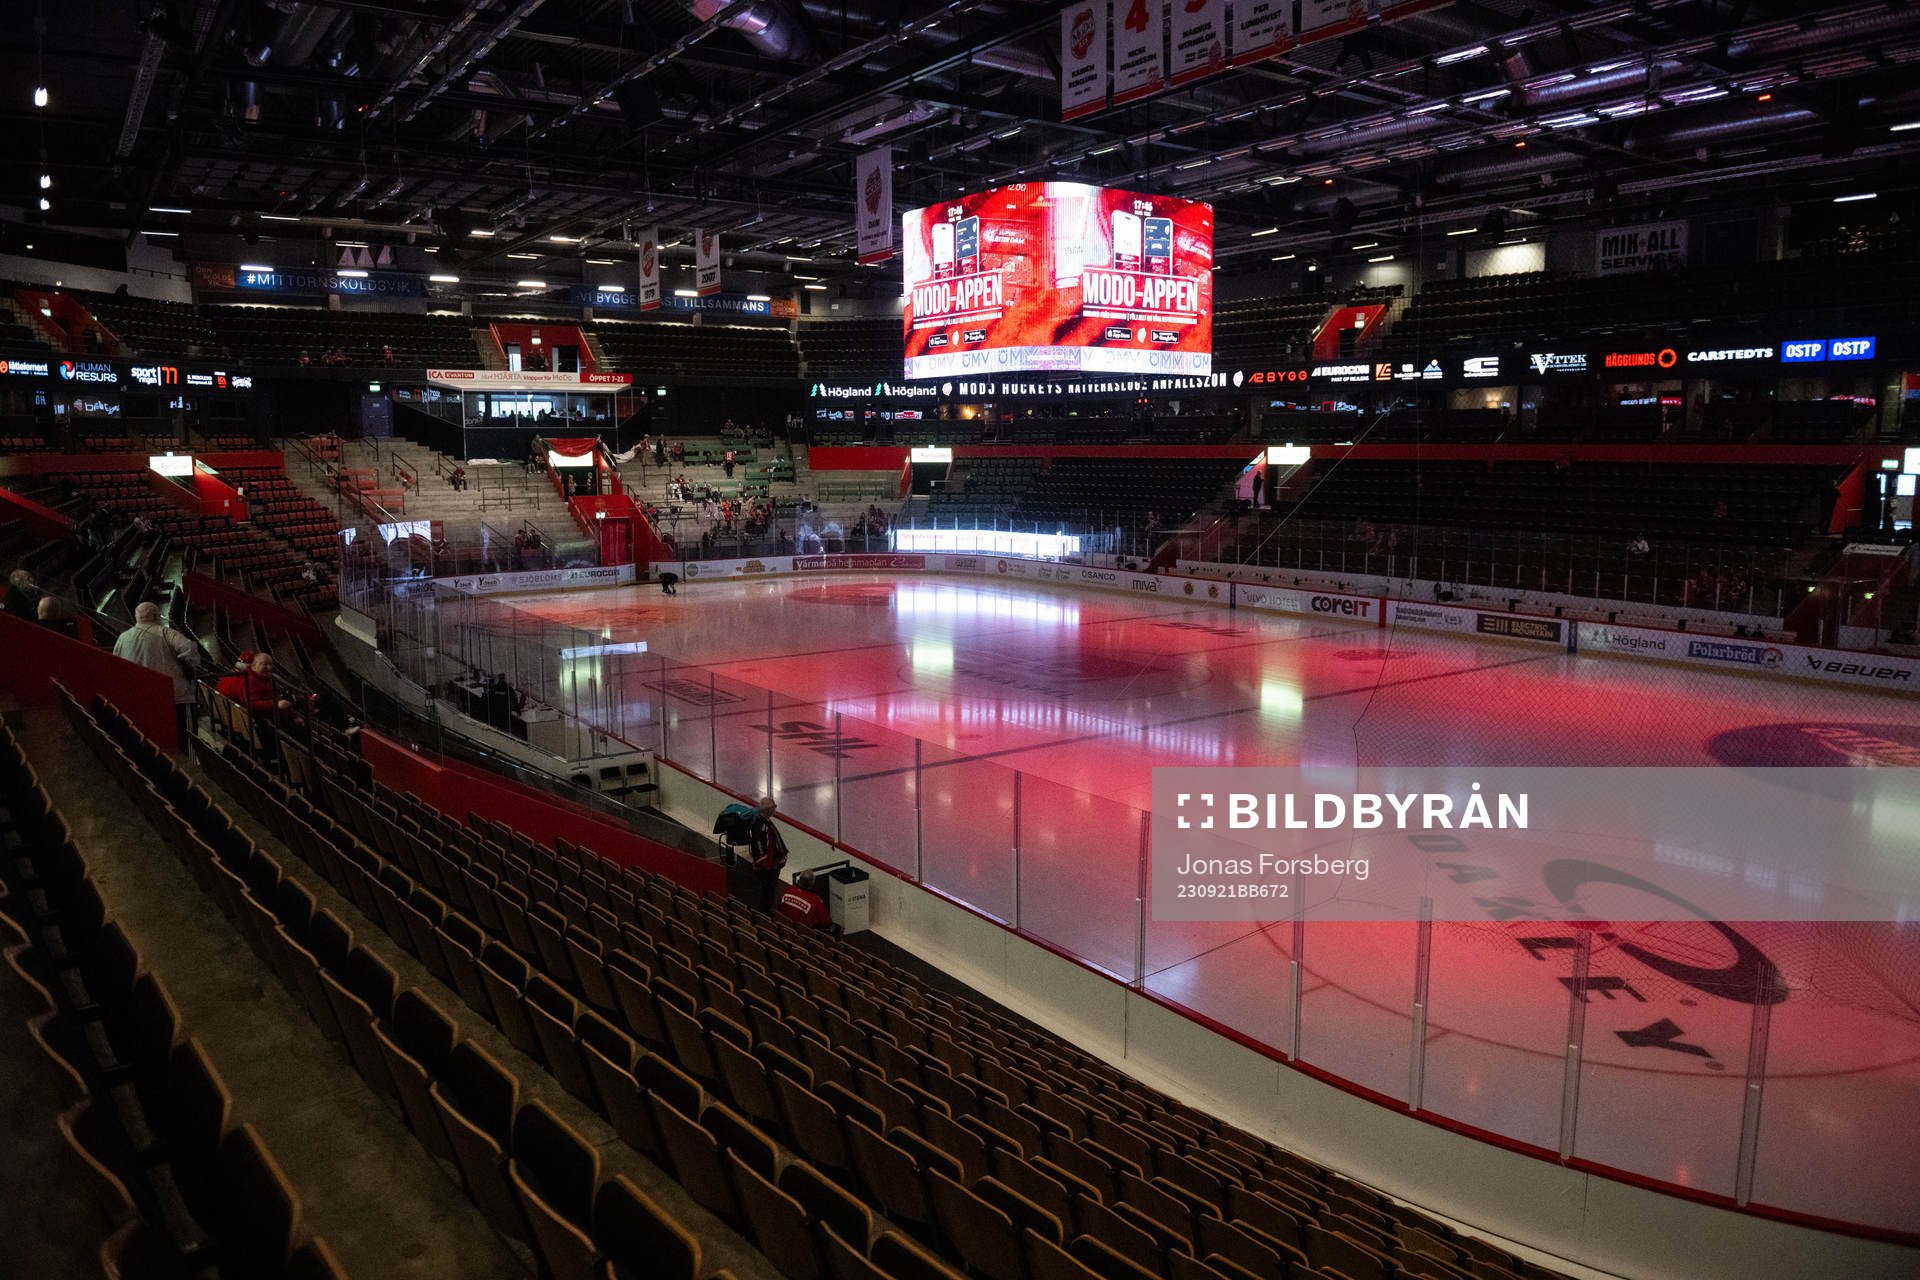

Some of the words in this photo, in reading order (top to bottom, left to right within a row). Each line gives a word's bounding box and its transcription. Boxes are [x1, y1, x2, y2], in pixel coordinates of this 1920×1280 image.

[1125, 0, 1150, 33] 4
[913, 273, 1002, 317] MODO-APPEN
[1083, 271, 1198, 312] MODO-APPEN
[596, 292, 641, 305] BYGGE
[682, 298, 764, 312] TILLSAMMANS
[1688, 348, 1774, 362] CARSTEDTS
[1786, 343, 1822, 358] OSTP
[1833, 341, 1870, 356] OSTP
[75, 362, 111, 372] HUMAN
[1605, 353, 1656, 367] HÄGGLUNDS
[76, 372, 118, 382] RESURS
[131, 367, 157, 379] sport
[587, 373, 610, 382] ÖPPET
[828, 385, 871, 397] Högland
[892, 385, 935, 397] Högland
[1088, 571, 1115, 581] SANCO
[1132, 577, 1157, 592] miva
[1311, 596, 1370, 617] coreIT
[1511, 622, 1548, 632] ELECTRIC
[1511, 627, 1553, 639] MOUNTAIN
[1612, 634, 1666, 651] Högland
[1692, 643, 1757, 663] Polarbröd
